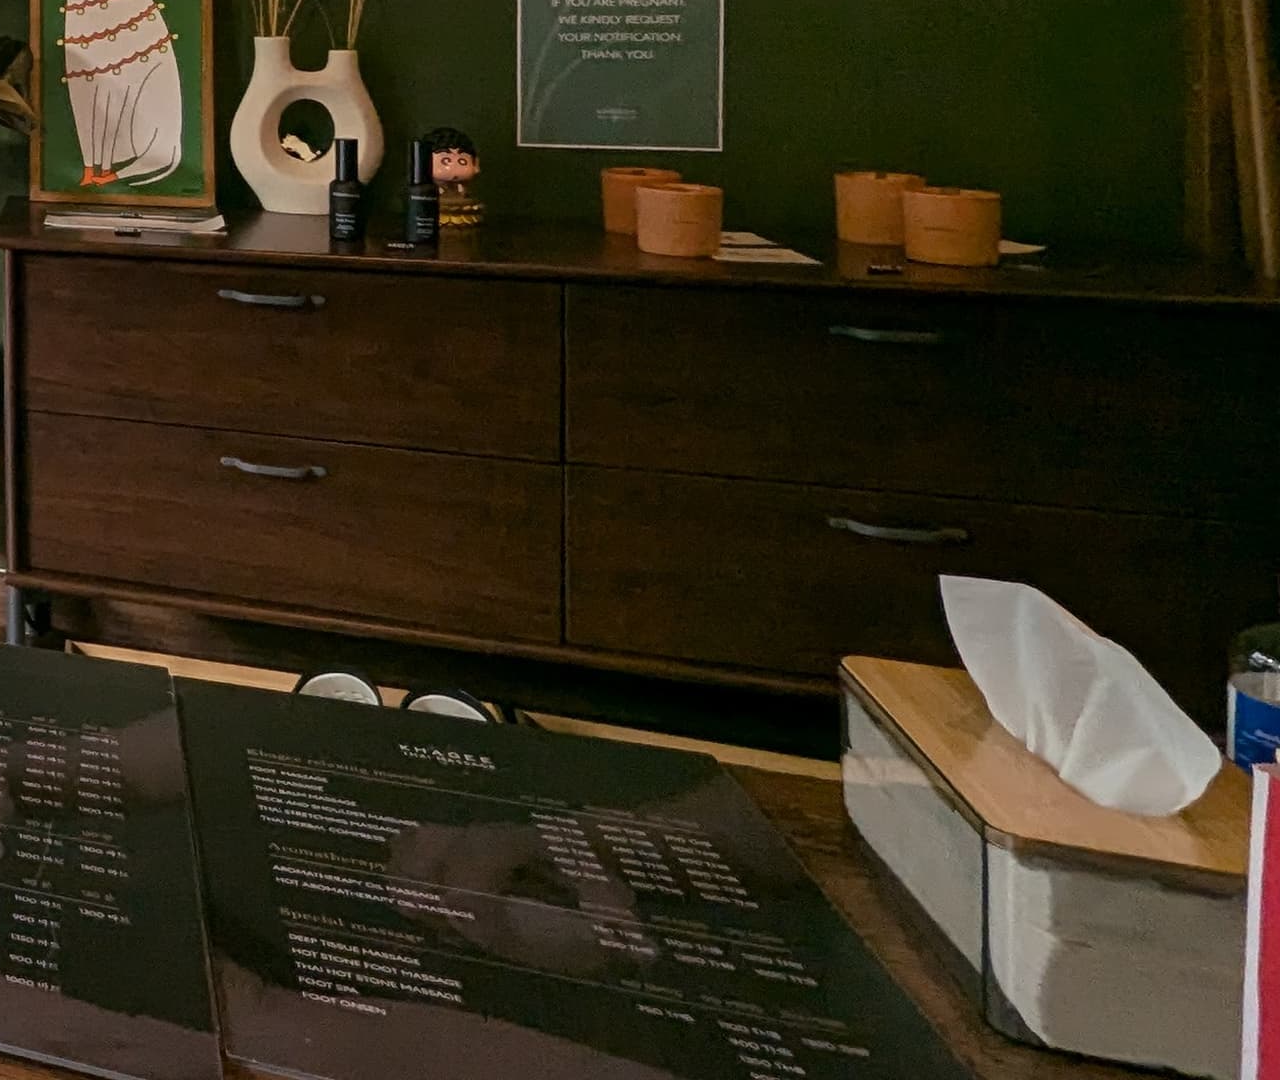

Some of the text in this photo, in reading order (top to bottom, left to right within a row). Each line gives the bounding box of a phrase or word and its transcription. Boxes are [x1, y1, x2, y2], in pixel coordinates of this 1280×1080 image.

[559, 14, 681, 24] WE KINDLY REQUEST
[558, 32, 591, 42] YOUR
[581, 50, 623, 59] THANK
[400, 744, 493, 764] KHAGEE
[298, 976, 332, 989] FOOT
